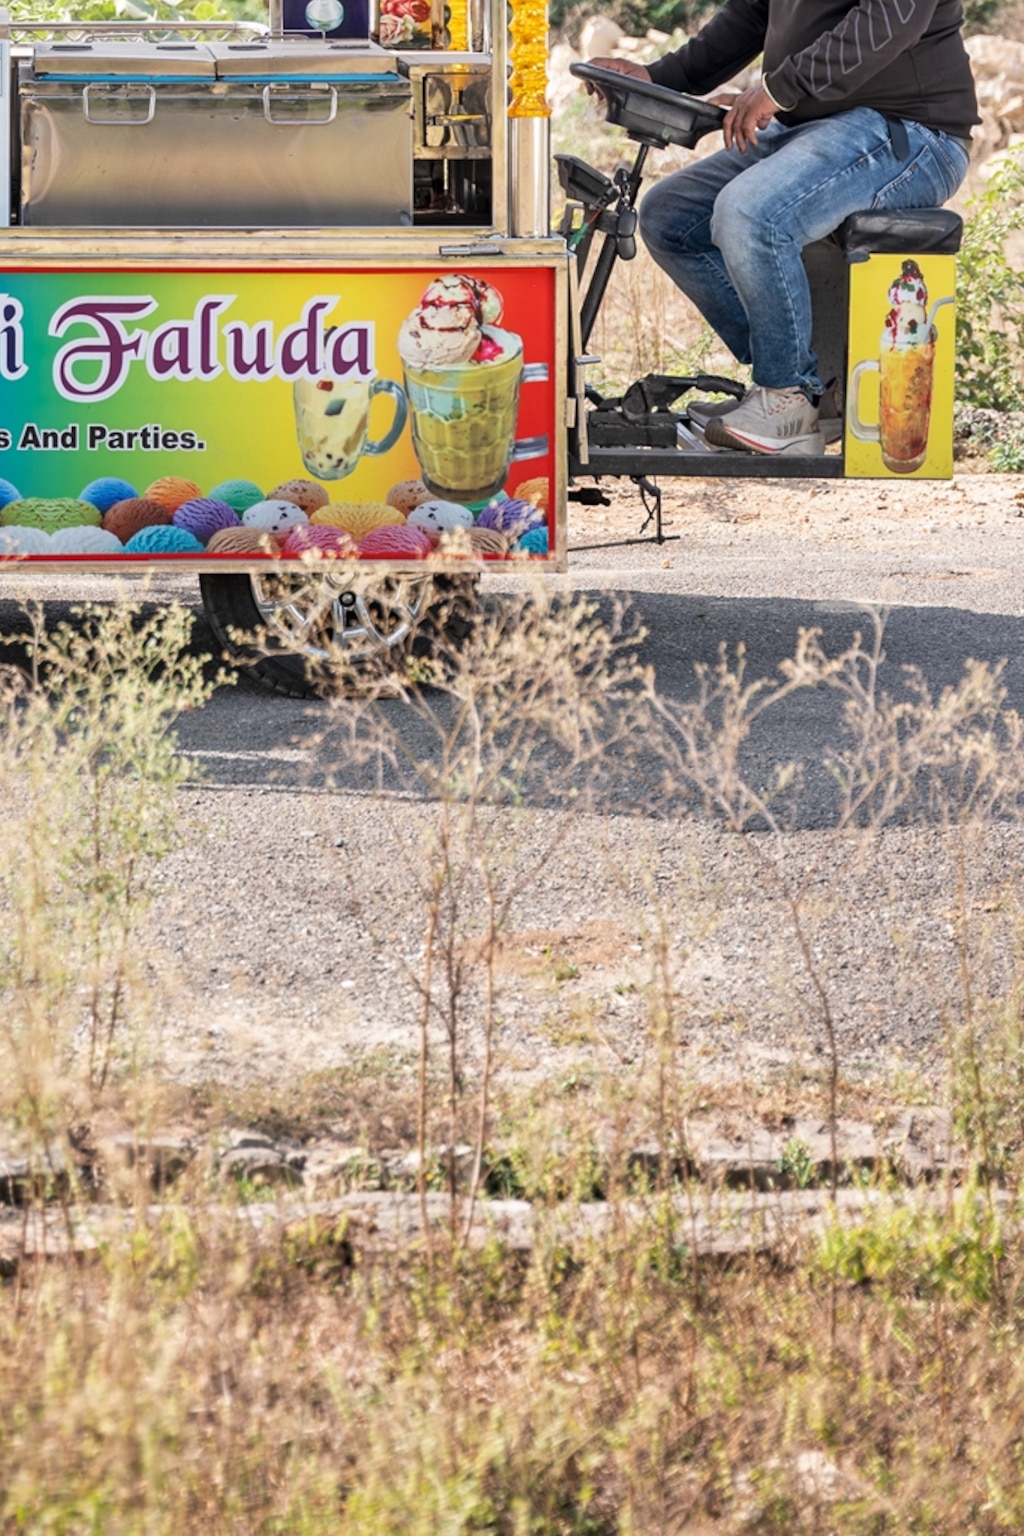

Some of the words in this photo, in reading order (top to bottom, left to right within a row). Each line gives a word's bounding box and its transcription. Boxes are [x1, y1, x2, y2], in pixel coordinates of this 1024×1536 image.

[48, 294, 379, 403] Faluda
[18, 423, 78, 451] And
[87, 423, 206, 451] Parties.
